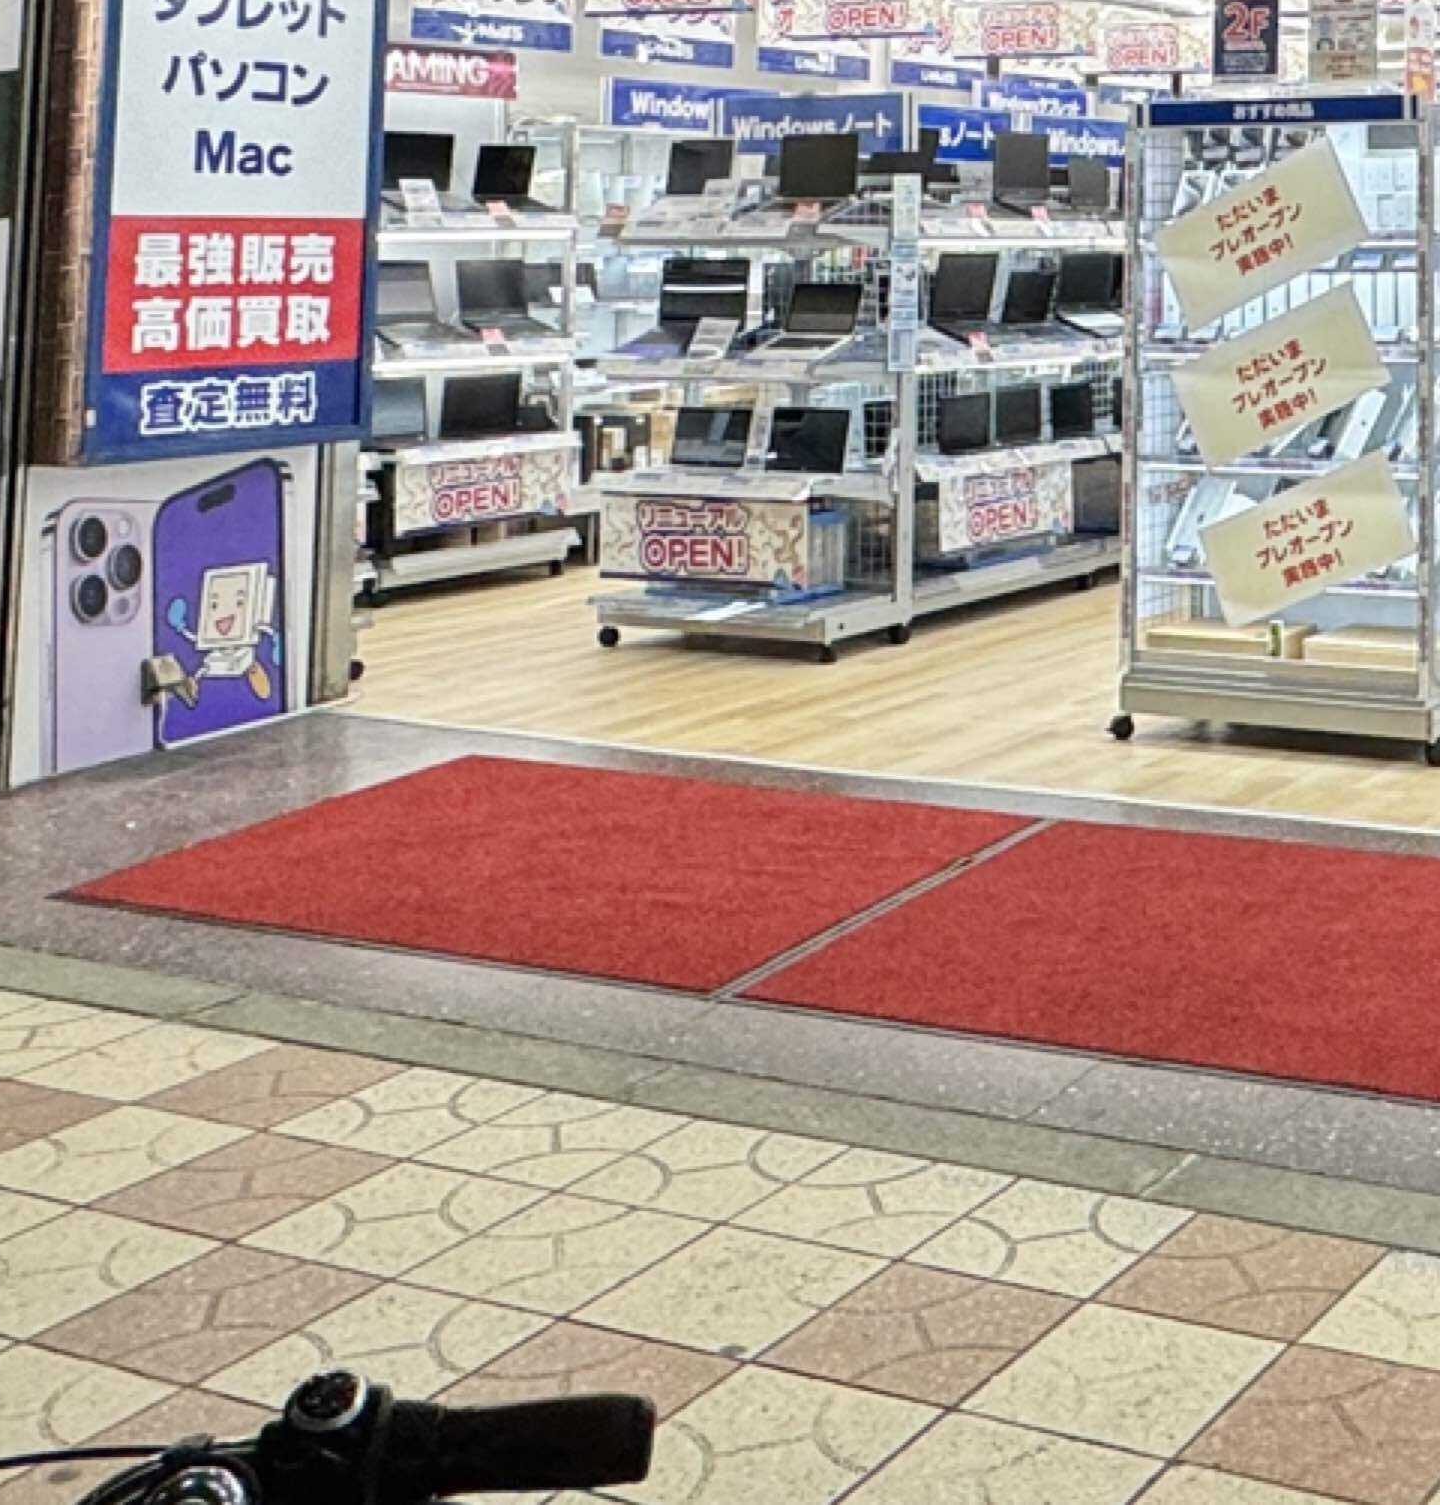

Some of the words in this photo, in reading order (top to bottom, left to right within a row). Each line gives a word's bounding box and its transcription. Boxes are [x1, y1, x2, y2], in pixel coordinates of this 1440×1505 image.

[826, 4, 905, 34] OPEN!
[1223, 1, 1270, 40] 2F
[983, 26, 1058, 52] OPEN!
[1108, 44, 1178, 69] OPEN!
[162, 52, 330, 106] パソコン
[194, 130, 294, 177] Mac
[1215, 184, 1282, 231] ただいま
[135, 233, 336, 286] 最強販売
[132, 295, 332, 352] 高価買取
[1235, 338, 1303, 384] ただいま
[141, 372, 317, 435] 査定無料
[430, 456, 523, 489] リニューアル
[965, 468, 1036, 498] リニューアル
[432, 484, 523, 520] OPEN!
[640, 502, 746, 535] リニューアル
[968, 502, 1038, 539] OPEN!
[1263, 498, 1331, 539] ただいま
[642, 538, 746, 574] OPEN!
